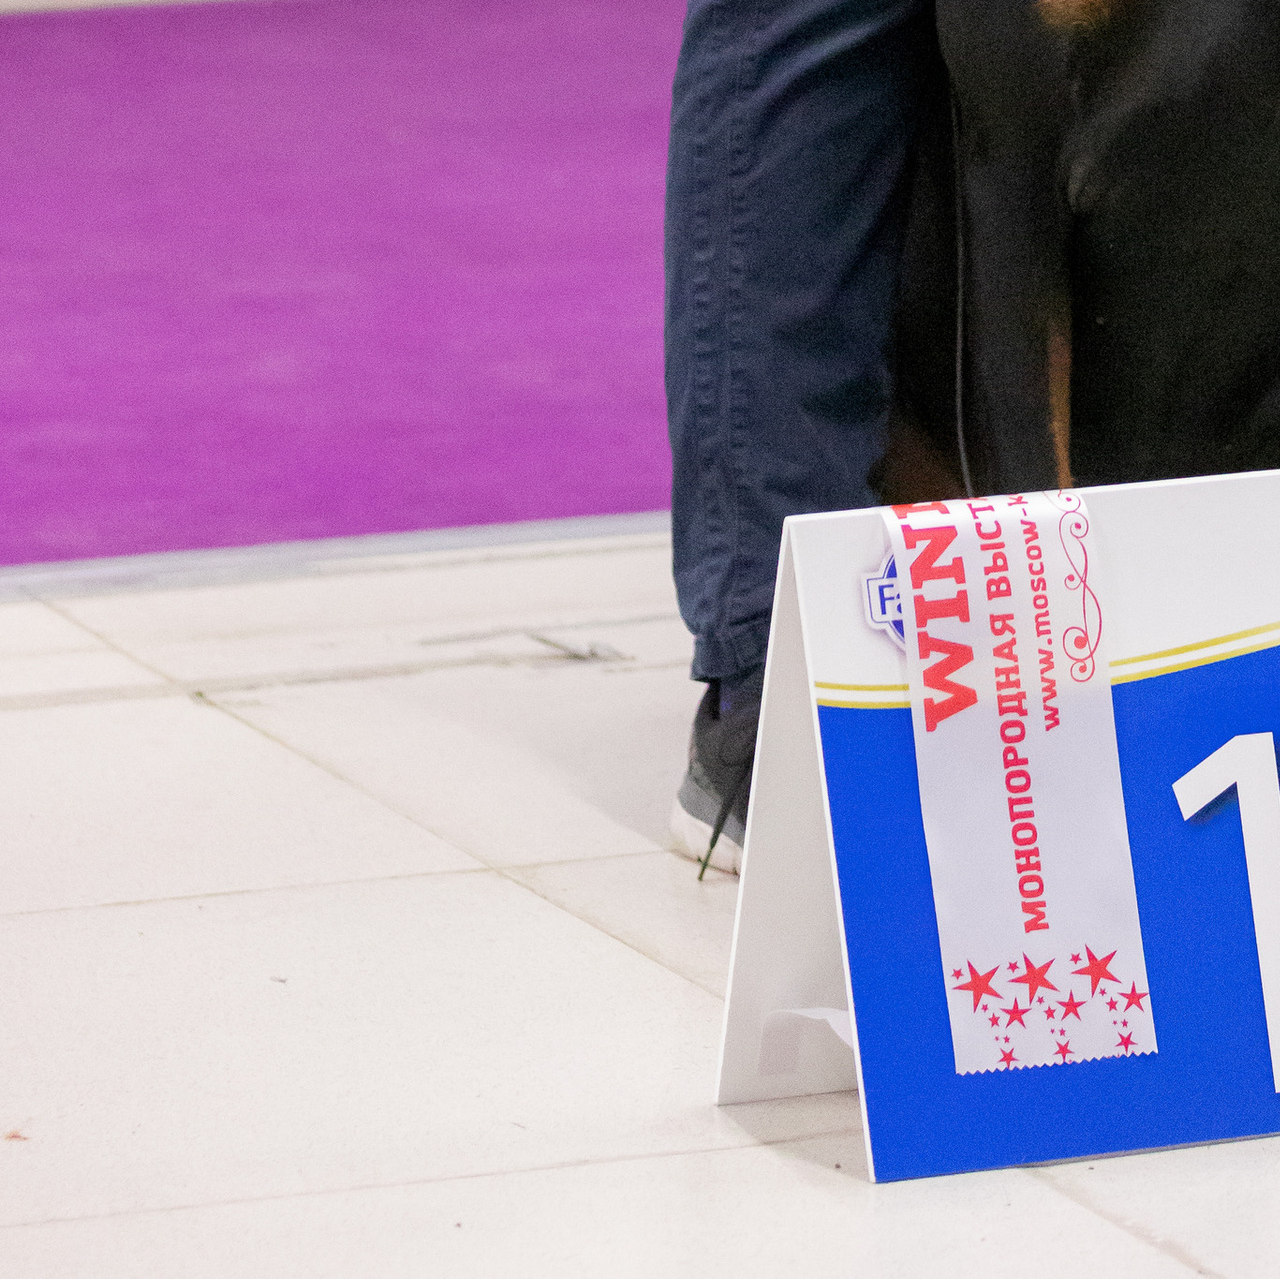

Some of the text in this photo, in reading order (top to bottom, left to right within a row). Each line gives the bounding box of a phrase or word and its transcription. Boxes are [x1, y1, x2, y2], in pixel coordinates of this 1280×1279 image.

[966, 497, 1050, 934] МОНОПОРОДНАЯ ВЫСТ
[1007, 494, 1061, 732] www.moscow-k
